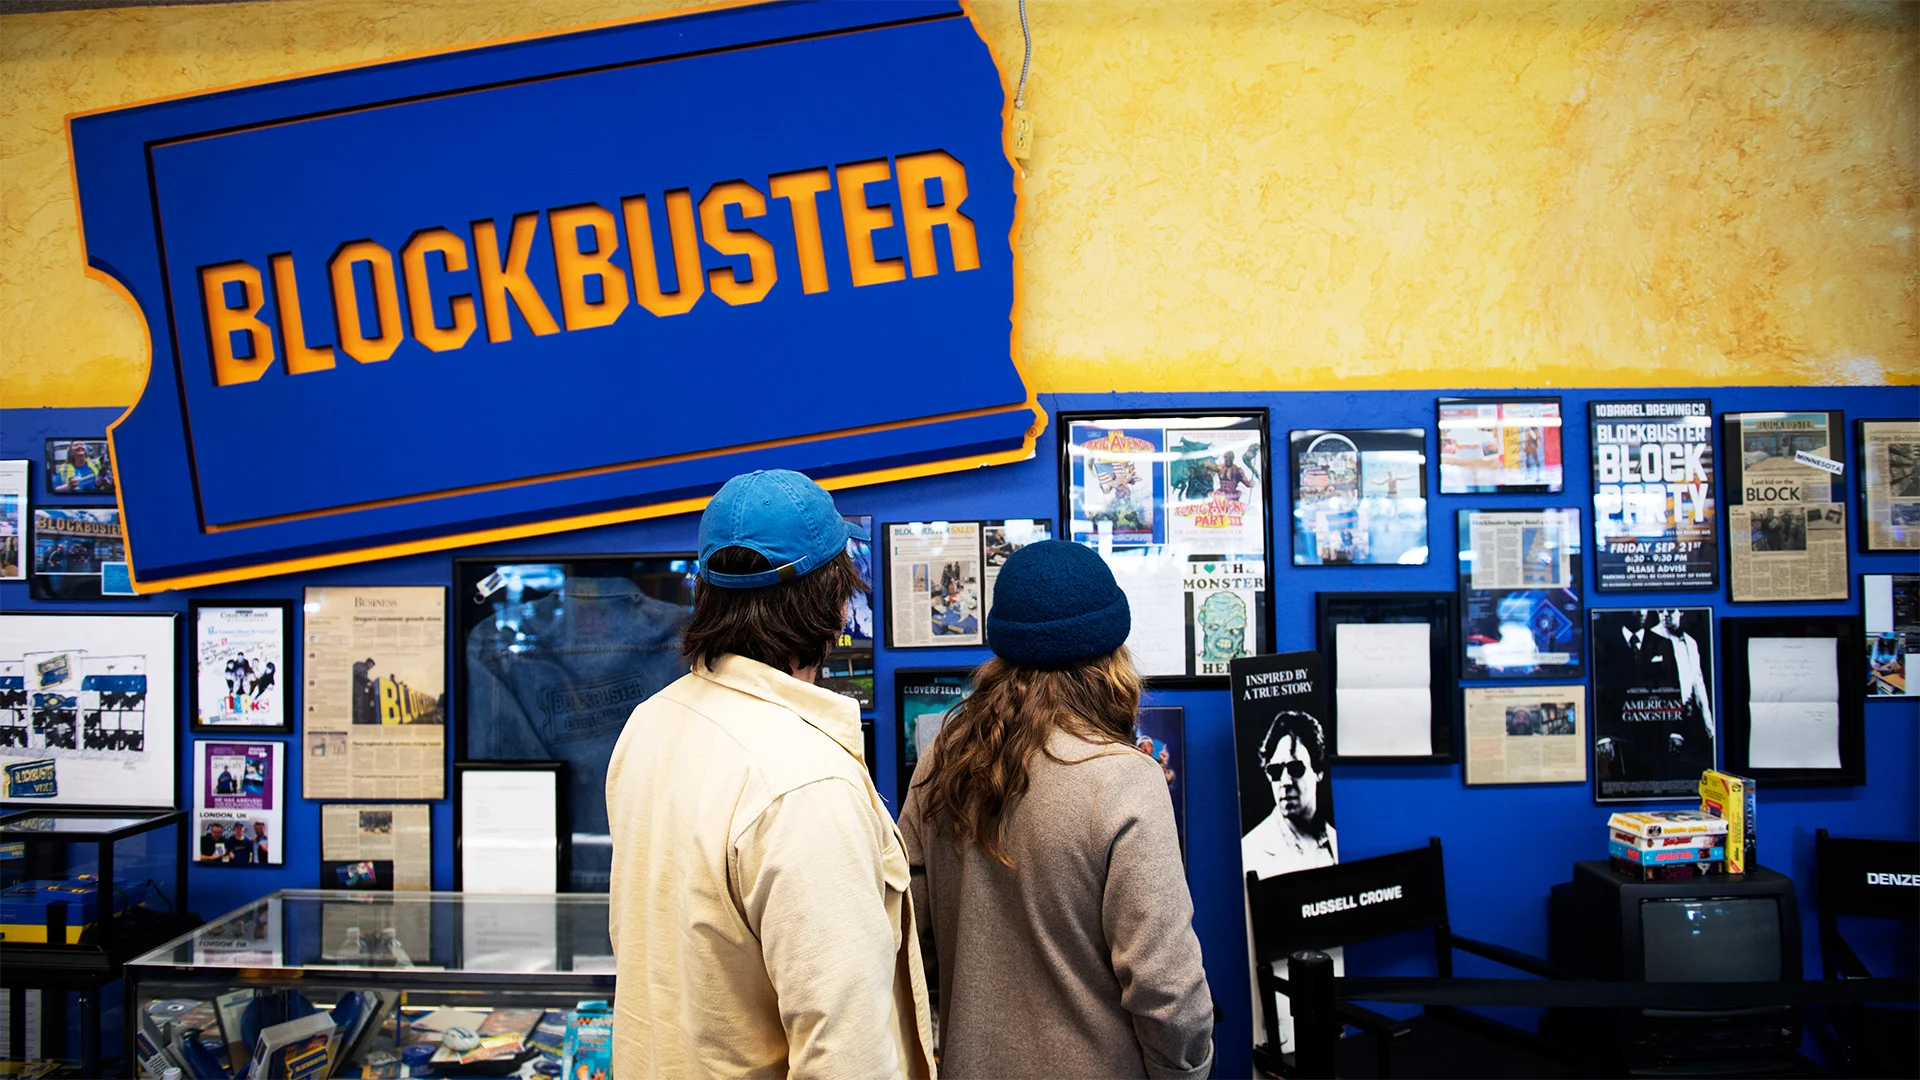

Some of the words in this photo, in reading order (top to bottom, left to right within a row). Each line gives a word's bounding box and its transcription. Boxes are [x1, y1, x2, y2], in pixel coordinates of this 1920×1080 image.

[196, 148, 981, 386] BLOCKBUSTER
[1606, 403, 1646, 417] BARREL
[1645, 402, 1692, 416] BREWING
[1596, 423, 1706, 443] BLOCKBUSTER
[1598, 443, 1708, 483] BLOCK
[1796, 453, 1842, 473] MINNESOTA
[1746, 486, 1800, 501] BLOCK
[1598, 483, 1709, 523] PARTY
[1194, 515, 1224, 526] PART
[1228, 515, 1243, 526] III
[950, 526, 975, 535] SALES
[1610, 542, 1652, 554] FRIDAY
[1654, 541, 1676, 553] SEP
[1679, 541, 1702, 552] 21ST
[1624, 554, 1645, 563] 6:30
[1652, 553, 1672, 563] 9:30
[1674, 553, 1688, 562] PM
[1192, 564, 1197, 574] I
[1626, 564, 1655, 574] PLEASE
[1657, 564, 1687, 573] ADVISE
[1183, 578, 1264, 590] MONSTER
[354, 596, 398, 608] BUSINESS
[1245, 670, 1294, 687] INSPIRED
[1295, 668, 1309, 680] BY
[903, 685, 961, 695] CLOVERFIELD
[1243, 689, 1251, 701] A
[1252, 684, 1280, 700] TRUE
[1281, 680, 1314, 696] STORY
[553, 682, 646, 714] BLOCKBUSTER
[1622, 700, 1682, 710] AMERICAN
[1621, 711, 1683, 721] GANGSTER
[1866, 872, 1920, 887] DENZE
[1301, 895, 1358, 918] RUSSELL
[1358, 885, 1403, 907] CROWE
